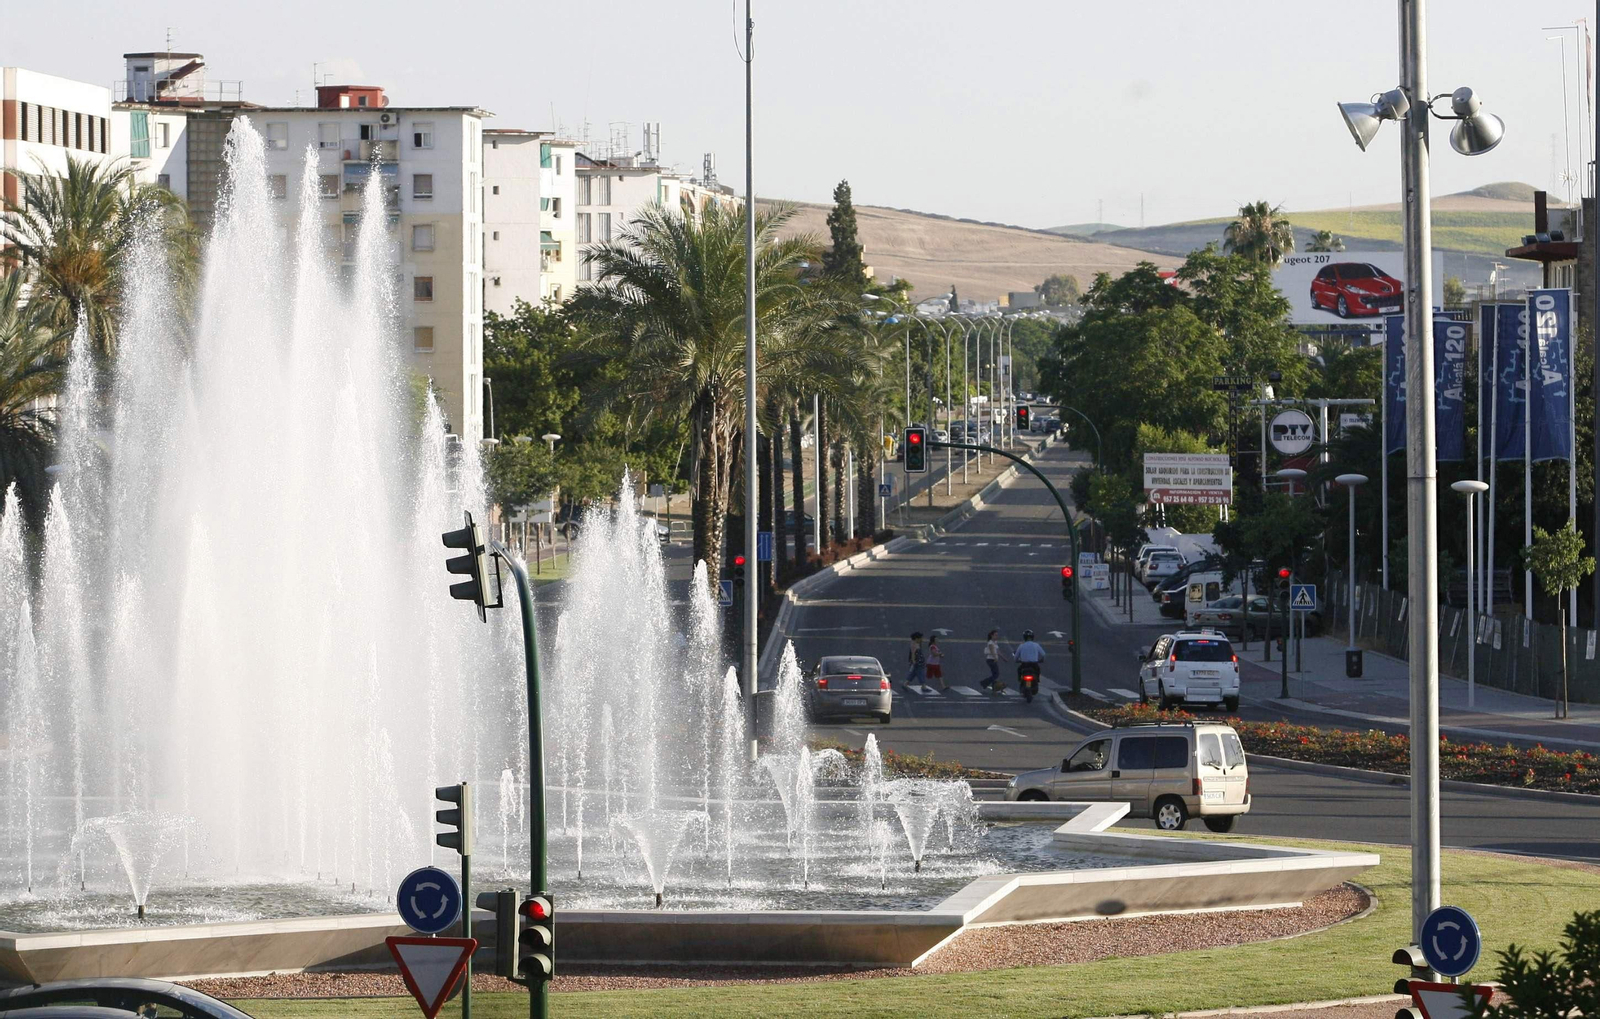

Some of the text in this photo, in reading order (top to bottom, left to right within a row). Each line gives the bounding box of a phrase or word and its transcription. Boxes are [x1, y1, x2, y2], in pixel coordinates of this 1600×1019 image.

[1284, 255, 1330, 266] ugeot 207
[1444, 325, 1466, 362] 120
[1214, 377, 1252, 385] PARKING
[1179, 467, 1190, 475] PARA
[1191, 467, 1196, 475] LA
[1193, 478, 1223, 486] APARCAMIENTOS
